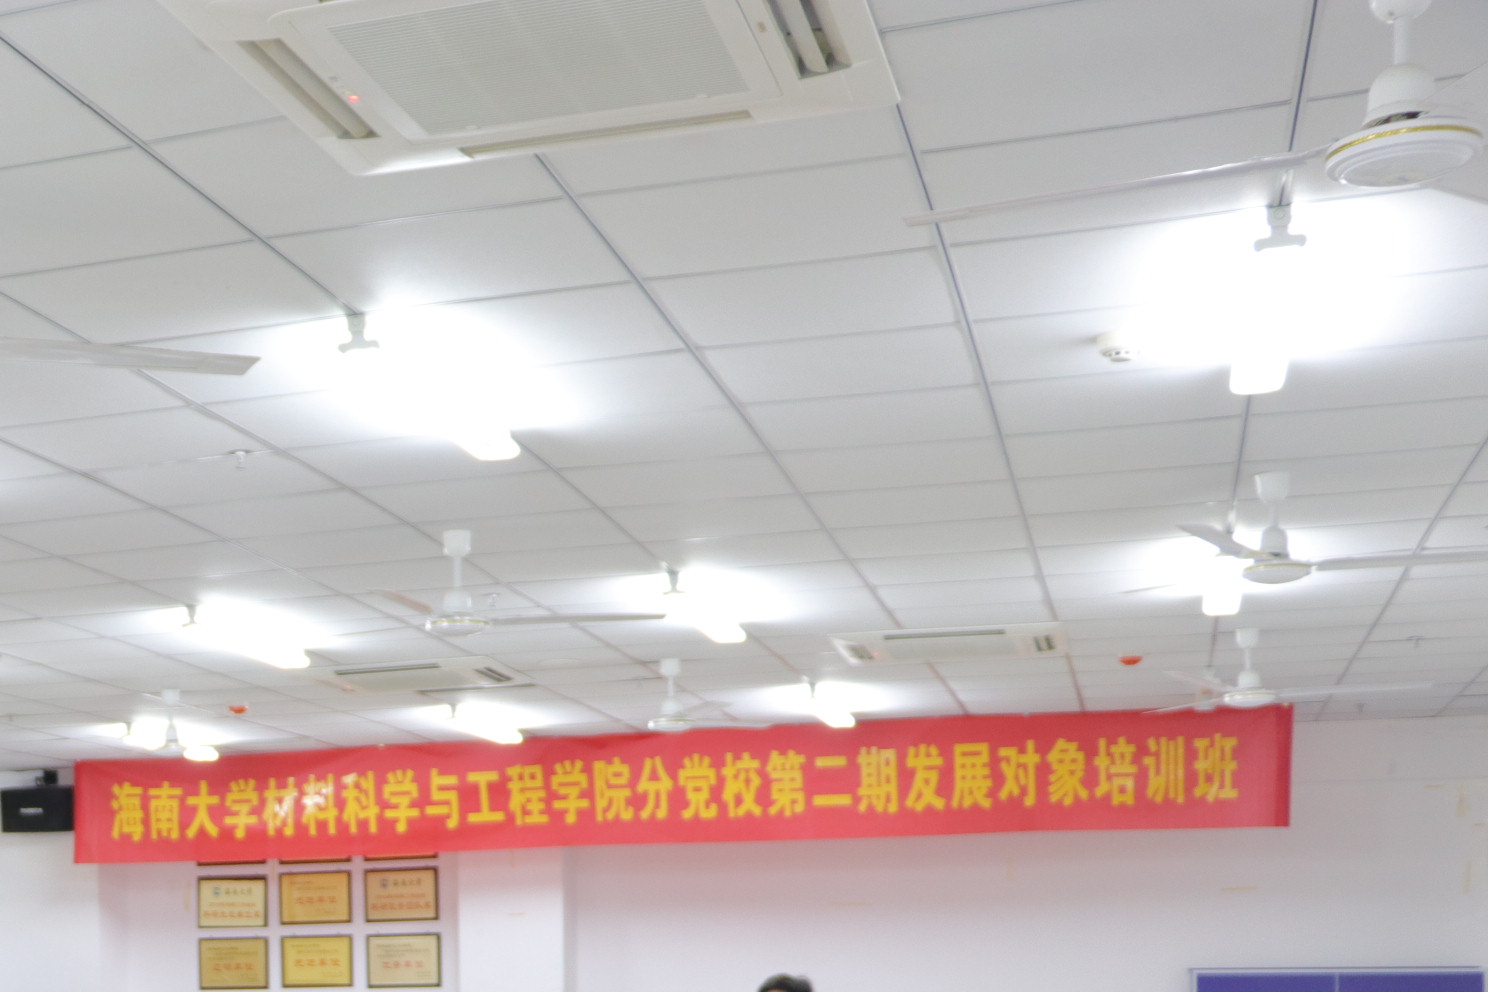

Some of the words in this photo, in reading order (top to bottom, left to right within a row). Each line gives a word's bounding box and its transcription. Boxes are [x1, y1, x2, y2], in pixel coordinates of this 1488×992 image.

[109, 733, 1239, 842] 海南大学材料科学与工程学院分党校第二期发展对象培训班
